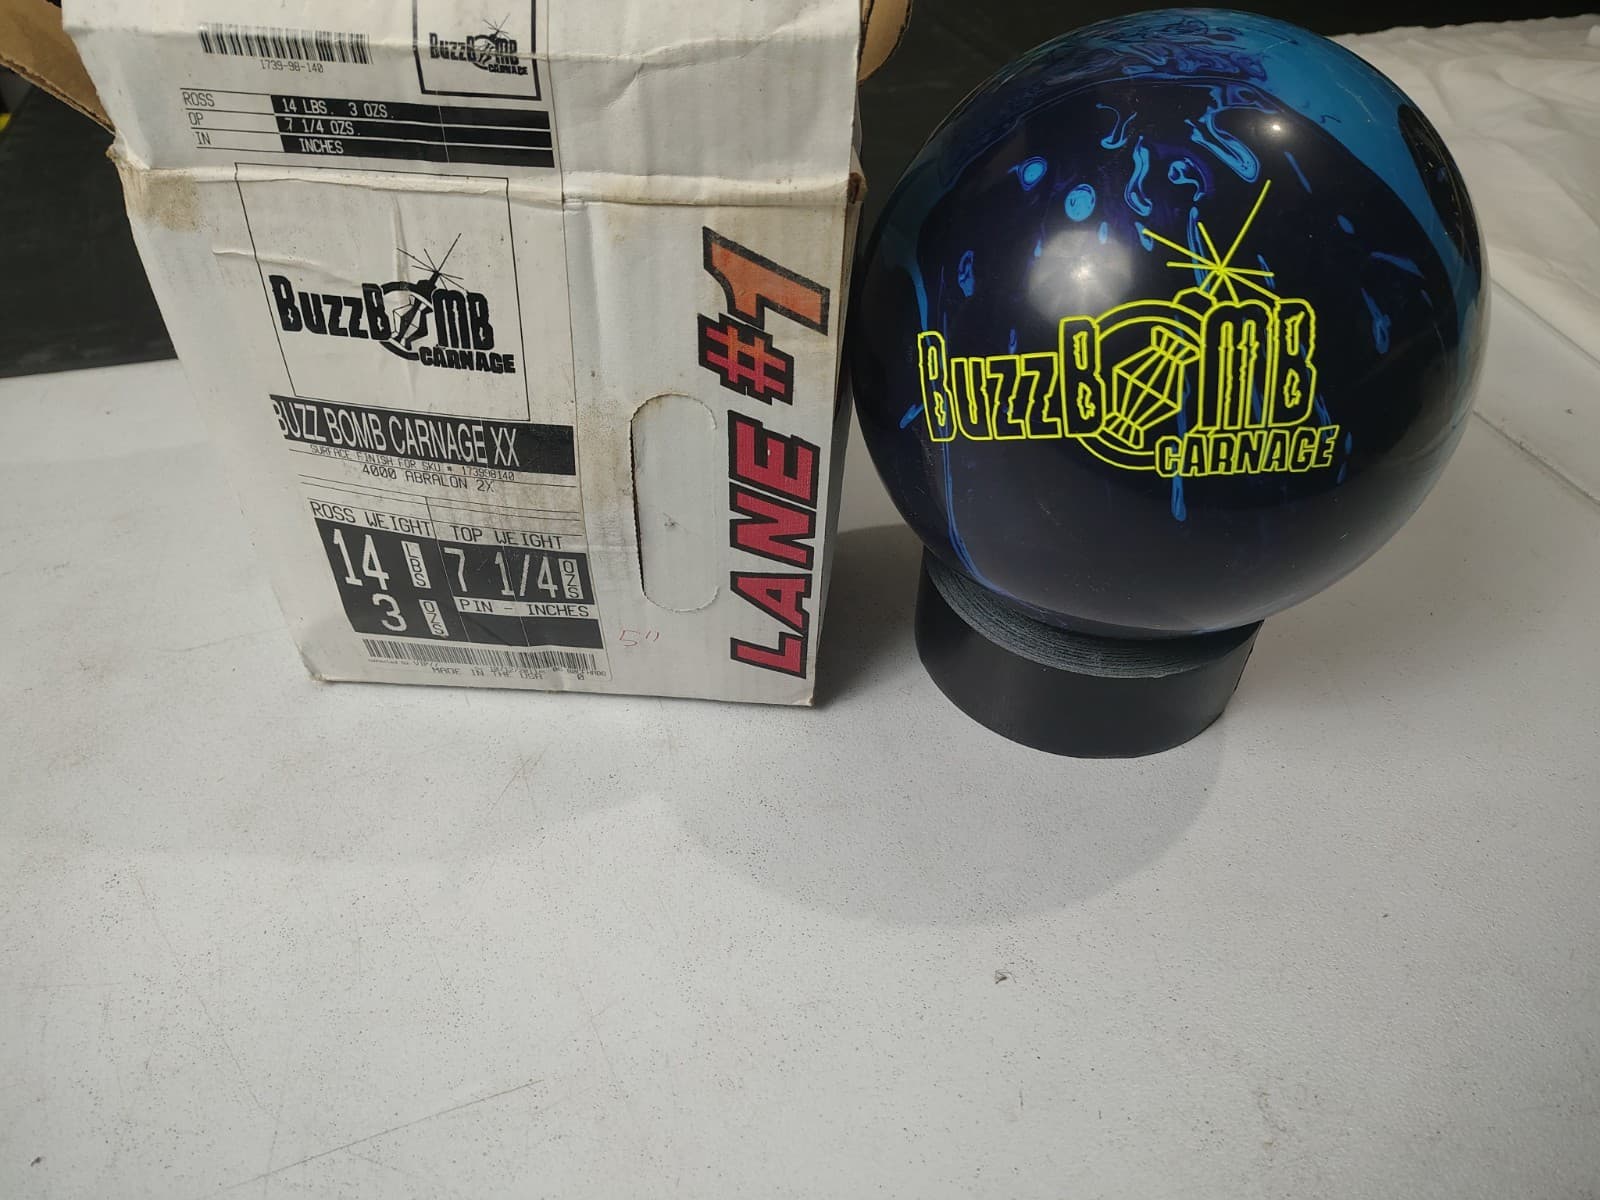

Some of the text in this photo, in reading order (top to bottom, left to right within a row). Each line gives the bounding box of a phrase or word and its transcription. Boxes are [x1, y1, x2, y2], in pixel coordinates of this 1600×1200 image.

[259, 59, 325, 73] 1739-98-140
[182, 91, 216, 108] ROSS
[282, 98, 297, 113] 14
[348, 102, 359, 117] 3
[188, 112, 204, 126] OP
[284, 117, 294, 132] 7
[301, 119, 325, 134] 1/4
[195, 131, 344, 154] IN INCHES
[418, 345, 516, 374] CARNAGE
[272, 399, 521, 468] BUZZ BOMB CARNAGE XX
[310, 444, 352, 460] SURFACE
[356, 450, 394, 466] FINISH
[399, 459, 416, 470] FOR
[422, 461, 441, 472] SKU
[698, 226, 830, 679] LANE #1
[1155, 425, 1340, 477] CARNAGE
[362, 463, 496, 493] 4000 ABRALON 2X
[310, 501, 433, 537] ROSS WEIGHT
[451, 525, 562, 550] TOP WEIGHT
[333, 528, 426, 591] 14 LBS
[443, 547, 580, 599] 7 1/4 OZS
[372, 593, 444, 635] 3 OZS
[460, 599, 494, 613] PIN
[527, 603, 590, 617] INCHES
[432, 666, 460, 675] MADE
[471, 668, 485, 676] IN
